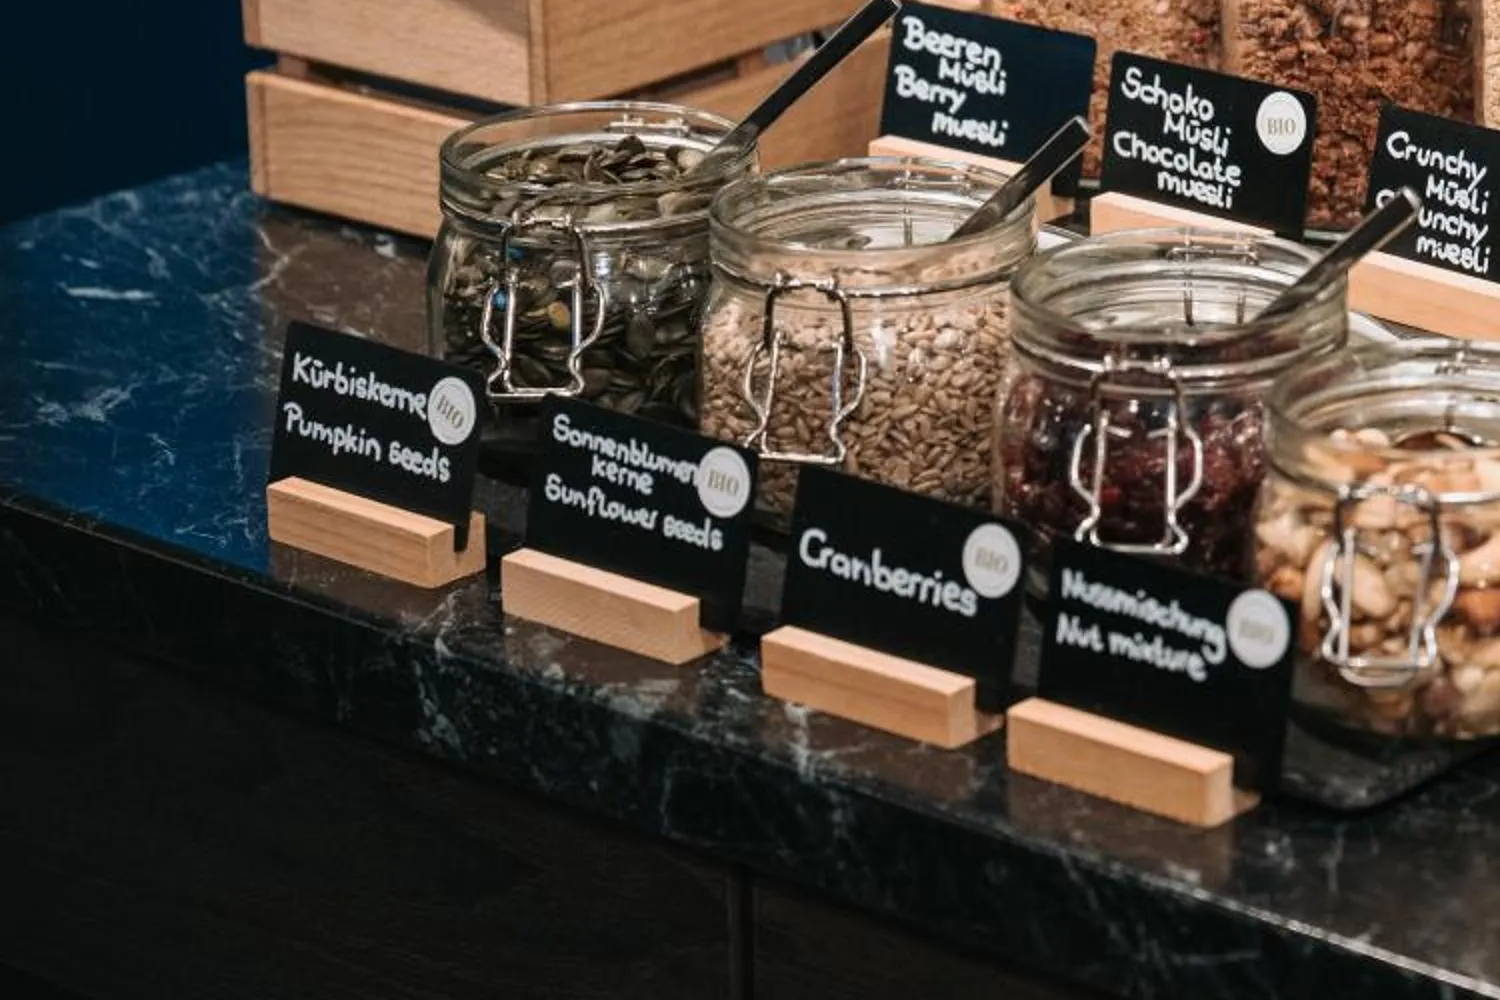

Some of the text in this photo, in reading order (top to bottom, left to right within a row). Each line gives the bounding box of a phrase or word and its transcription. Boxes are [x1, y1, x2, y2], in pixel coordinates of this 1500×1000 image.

[901, 16, 1001, 71] Beeren
[894, 64, 967, 114] Berry
[938, 57, 1008, 96] Müsli
[1121, 66, 1215, 122] Schoko
[931, 111, 1009, 147] muesli
[1163, 110, 1232, 158] Müsli
[1266, 117, 1297, 137] BIO
[1113, 130, 1241, 187] Chocolate
[1386, 130, 1487, 192] Crunchy
[1157, 171, 1233, 210] muesli
[1425, 173, 1491, 215] Müsli
[1375, 188, 1489, 247] Cunchy
[1416, 235, 1491, 274] muesli
[292, 352, 428, 421] Kürbiskerne
[434, 394, 464, 429] BIO
[283, 401, 450, 482] Pumpkin seeds
[591, 454, 654, 496] kerne
[707, 468, 740, 497] BIO
[544, 472, 724, 551] Sunflower seeds
[799, 527, 978, 617] Cranberries
[1056, 611, 1208, 683] Nut mixture
